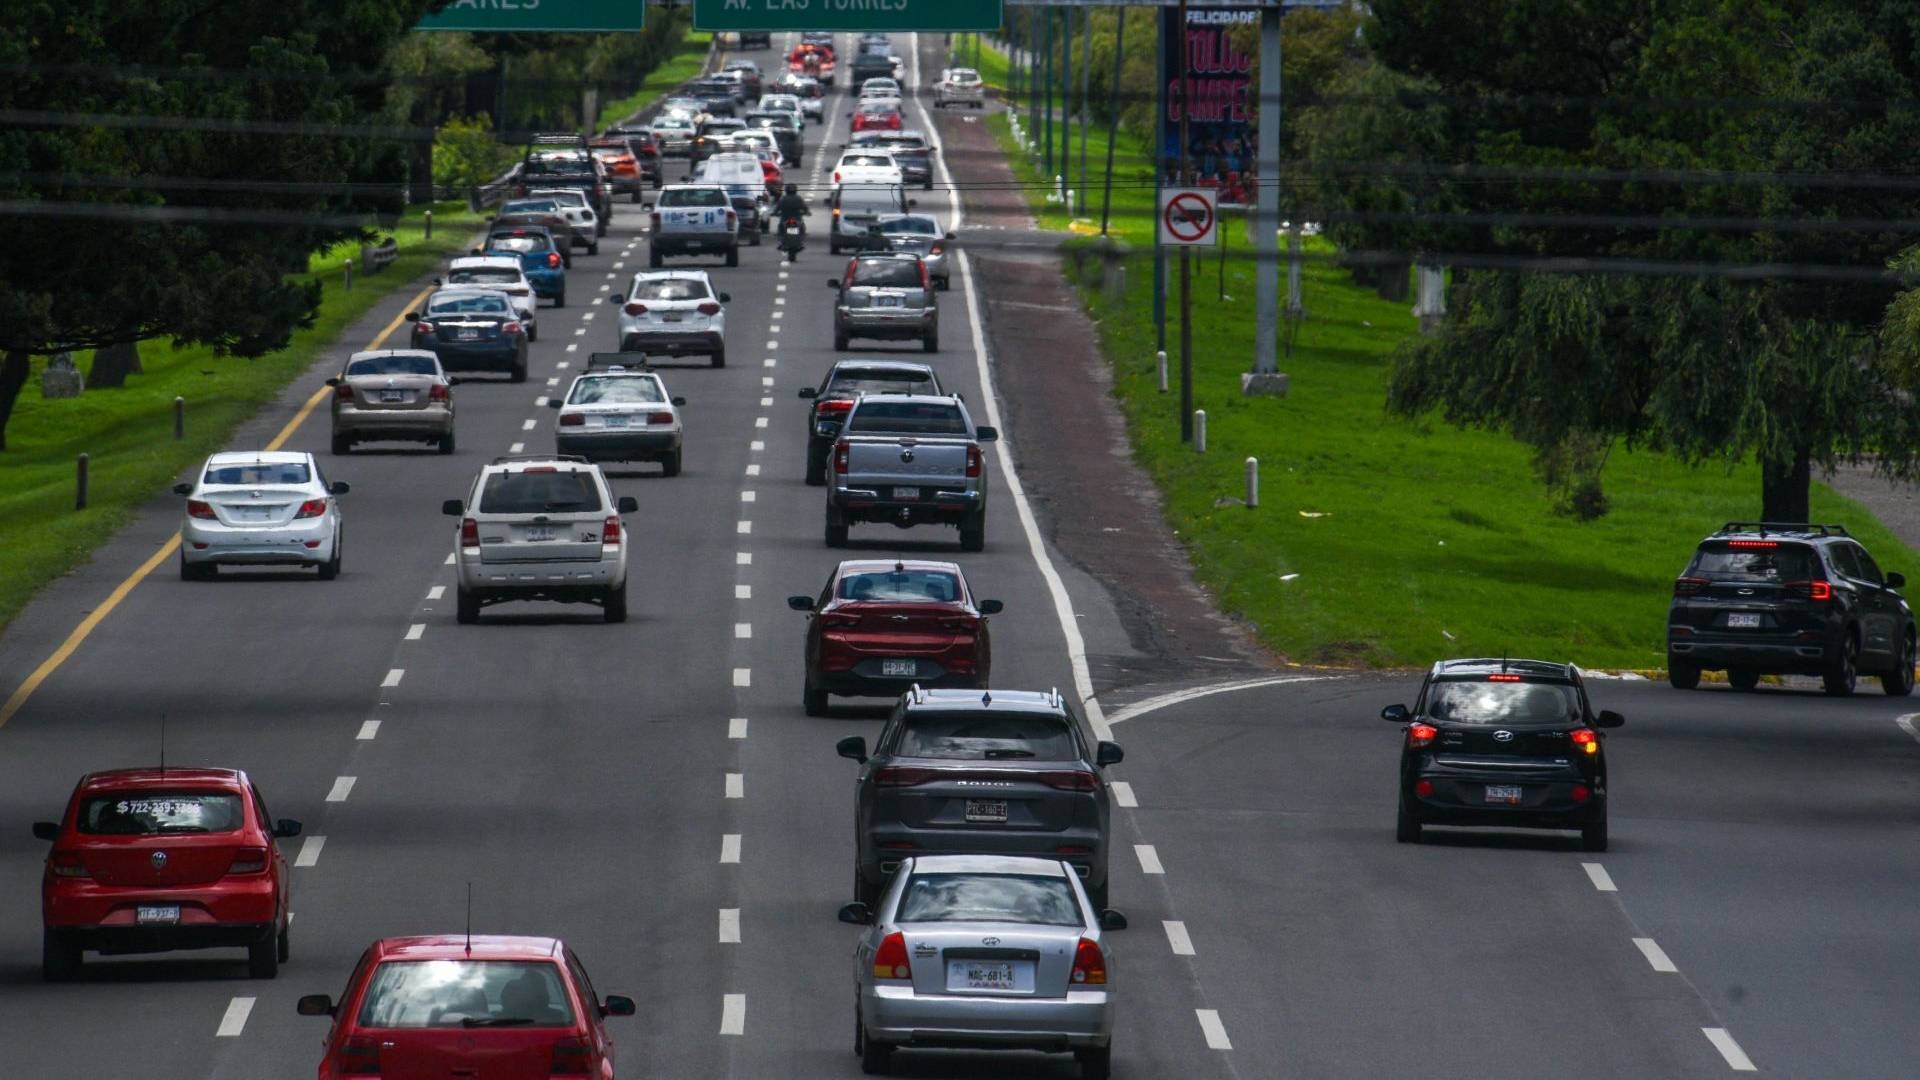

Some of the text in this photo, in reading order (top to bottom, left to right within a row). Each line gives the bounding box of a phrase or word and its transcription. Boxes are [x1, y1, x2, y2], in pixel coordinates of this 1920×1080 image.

[1186, 10, 1258, 24] FELICIDADE
[1183, 30, 1251, 73] TOLUC
[1168, 78, 1256, 122] CAMPE
